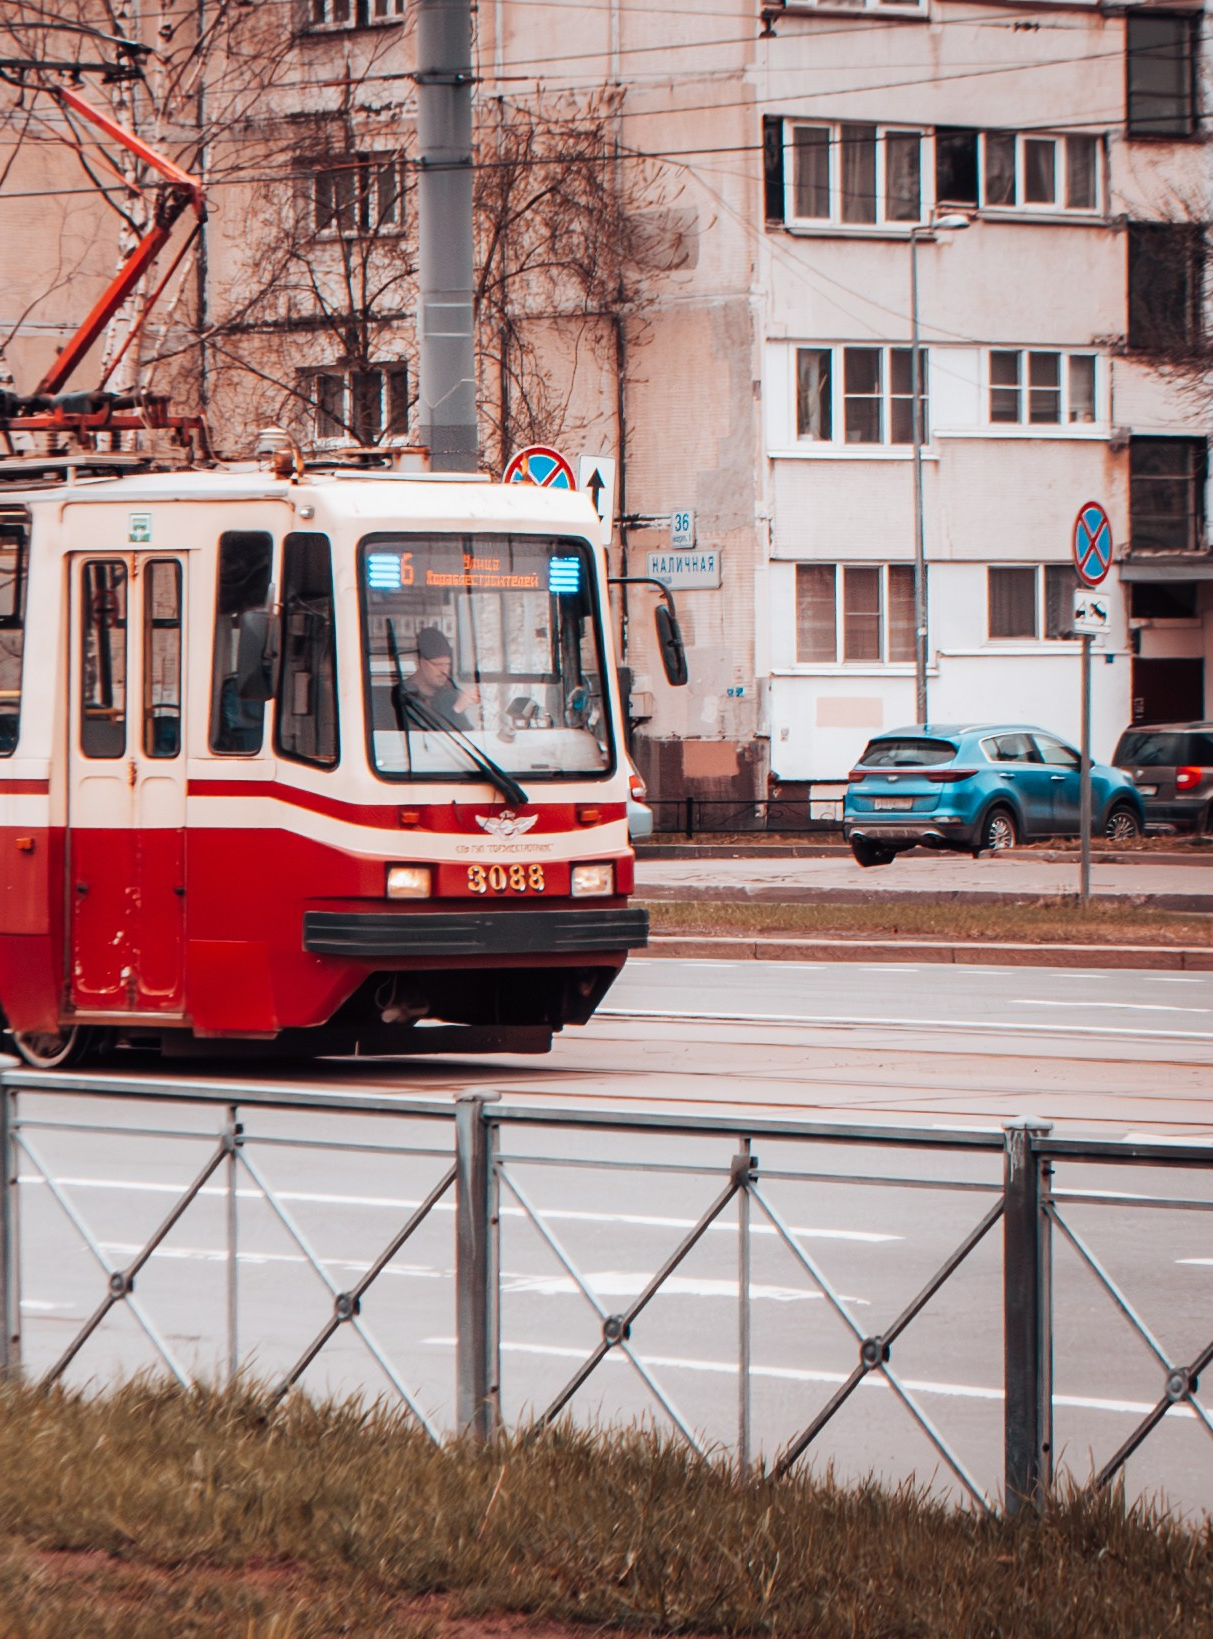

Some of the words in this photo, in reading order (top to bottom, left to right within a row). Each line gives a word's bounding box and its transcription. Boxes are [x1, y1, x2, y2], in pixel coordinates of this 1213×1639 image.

[675, 512, 690, 532] 36
[400, 552, 414, 586] 6
[652, 555, 714, 574] НАЛИЧНАЯ
[467, 864, 545, 893] 3088
